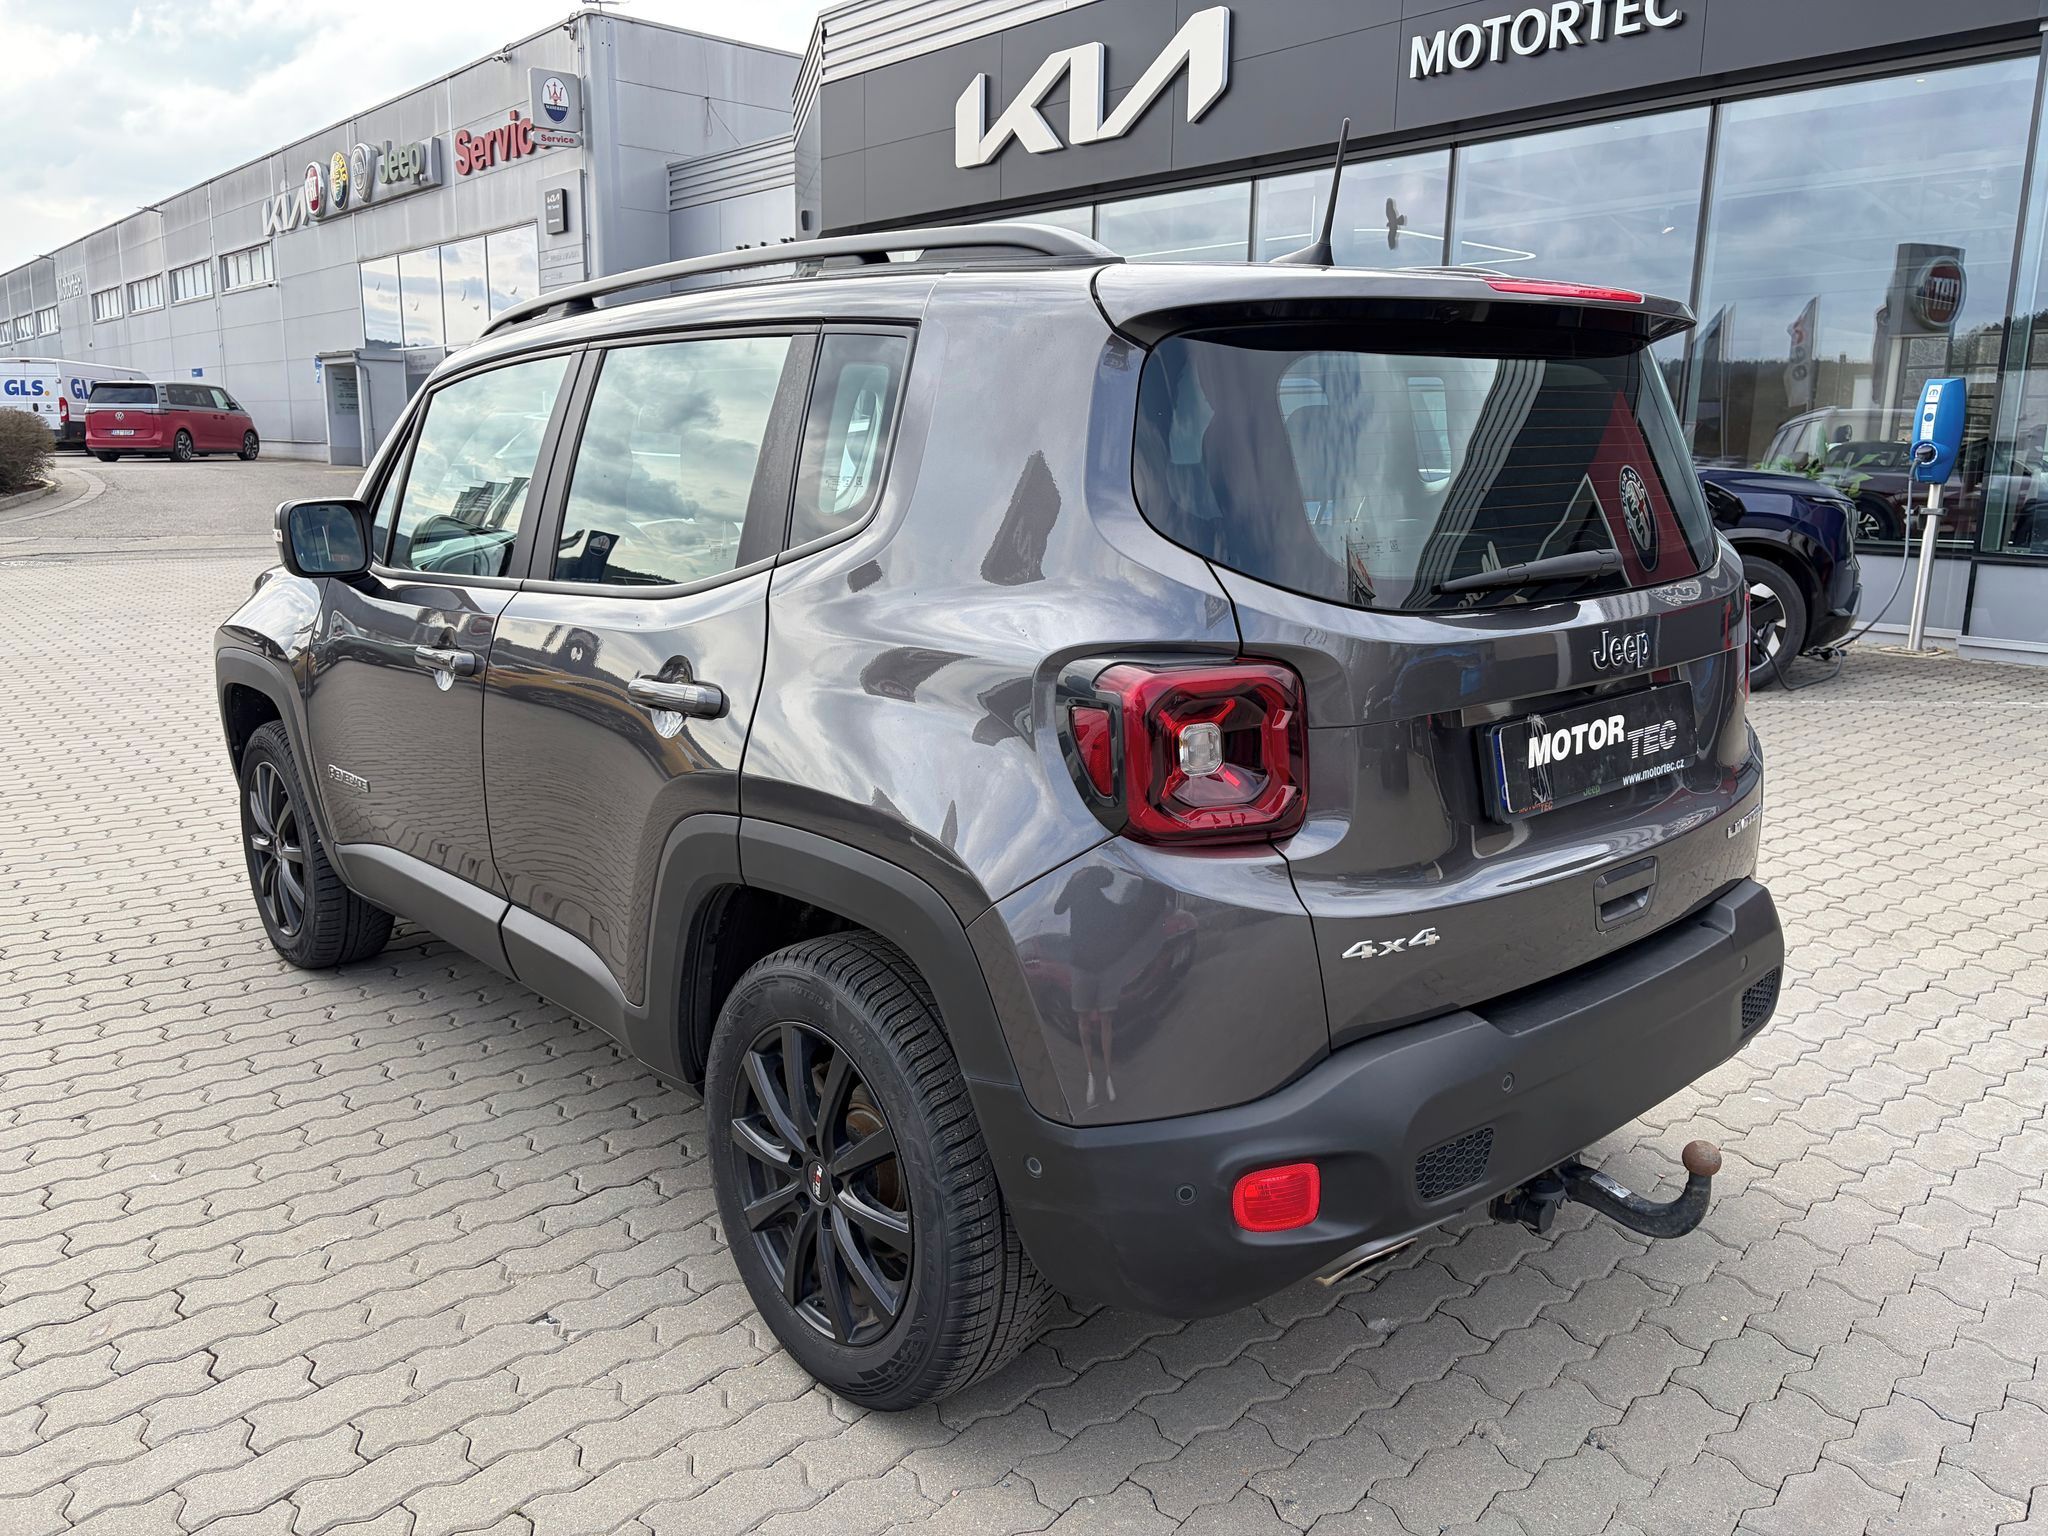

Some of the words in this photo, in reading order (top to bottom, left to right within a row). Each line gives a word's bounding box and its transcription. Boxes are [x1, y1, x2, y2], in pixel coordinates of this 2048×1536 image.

[955, 6, 1230, 168] KIA
[455, 110, 551, 175] Servic
[540, 133, 575, 144] Service
[378, 141, 424, 184] Jeep
[1592, 628, 1650, 670] Jeep
[1528, 714, 1625, 769] MOTOR
[1627, 719, 1677, 759] TEC
[328, 763, 369, 793] RENEGADE
[1622, 758, 1685, 786] www.motortec.cz
[1341, 927, 1441, 959] 4x4
